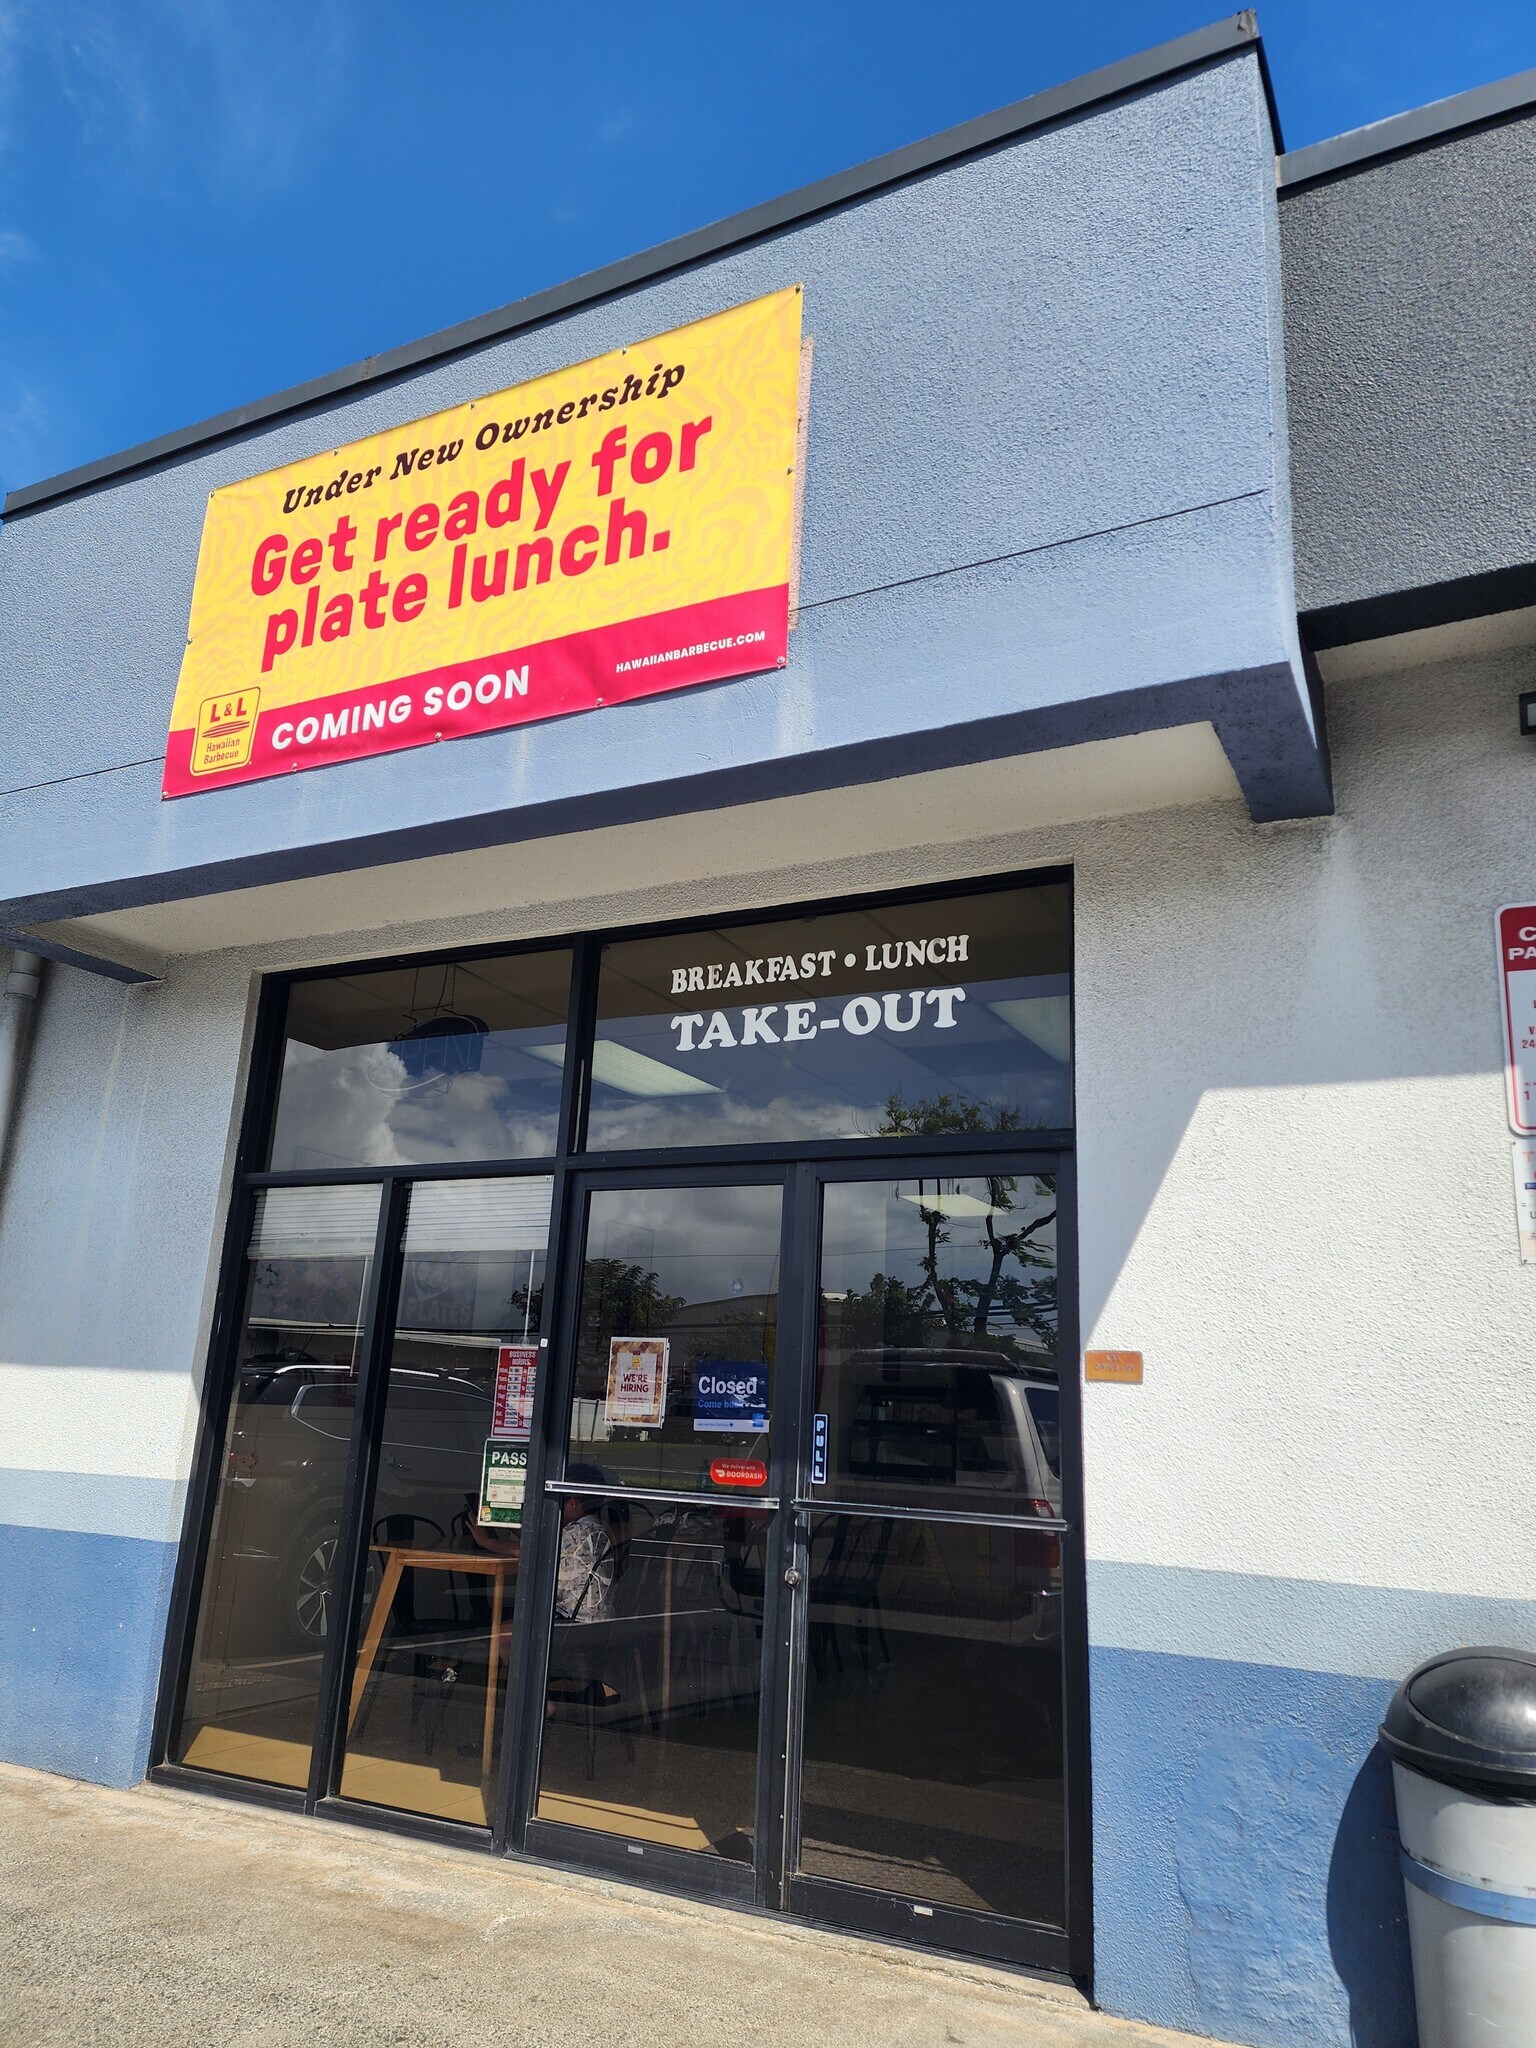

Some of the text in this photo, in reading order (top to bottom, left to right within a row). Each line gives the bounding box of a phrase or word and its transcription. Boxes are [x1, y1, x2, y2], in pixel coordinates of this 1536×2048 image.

[282, 363, 686, 514] Under New Ownership
[251, 415, 712, 596] Get ready for
[261, 497, 671, 673] plate lunch.
[616, 631, 766, 673] HAWAIIANBARBECUE.COM
[271, 665, 529, 750] COMING SOON
[203, 750, 239, 764] Barbecue
[206, 738, 240, 752] Hawaiian
[671, 934, 970, 994] BREAKFAST LUNCH
[670, 987, 966, 1051] TAKE-OUT
[620, 1383, 649, 1393] HIRING
[623, 1373, 648, 1383] WE'RE
[698, 1376, 758, 1395] Closed
[697, 1399, 722, 1409] Come
[491, 1451, 527, 1466] PASS
[815, 1420, 825, 1478] PULL
[726, 1471, 763, 1479] DOORDASH
